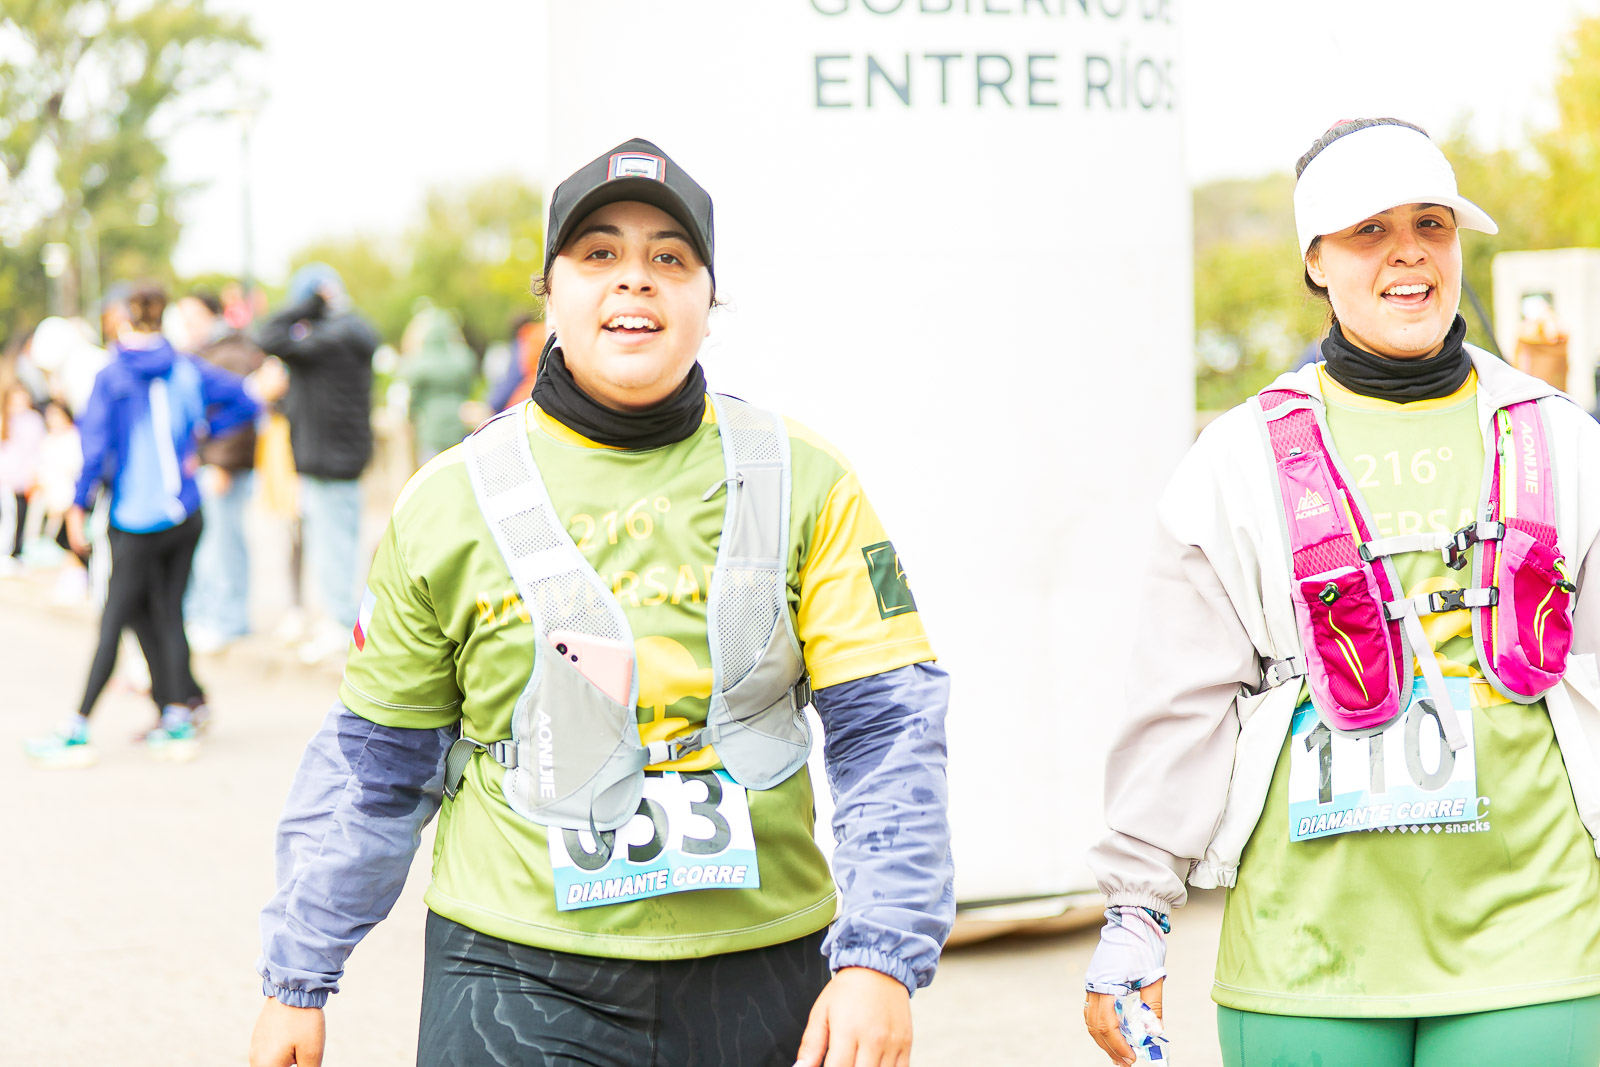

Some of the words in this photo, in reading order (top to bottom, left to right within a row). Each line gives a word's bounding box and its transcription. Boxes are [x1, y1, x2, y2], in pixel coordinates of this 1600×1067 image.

[814, 54, 1058, 108] ENTRE
[1353, 446, 1453, 488] 216°
[1304, 698, 1456, 804] 110
[1297, 804, 1394, 837] DIAMANTE
[1396, 798, 1467, 820] CORRE
[1445, 820, 1491, 834] snacks
[567, 869, 669, 905] DIAMANTE
[672, 865, 748, 887] CORRE
